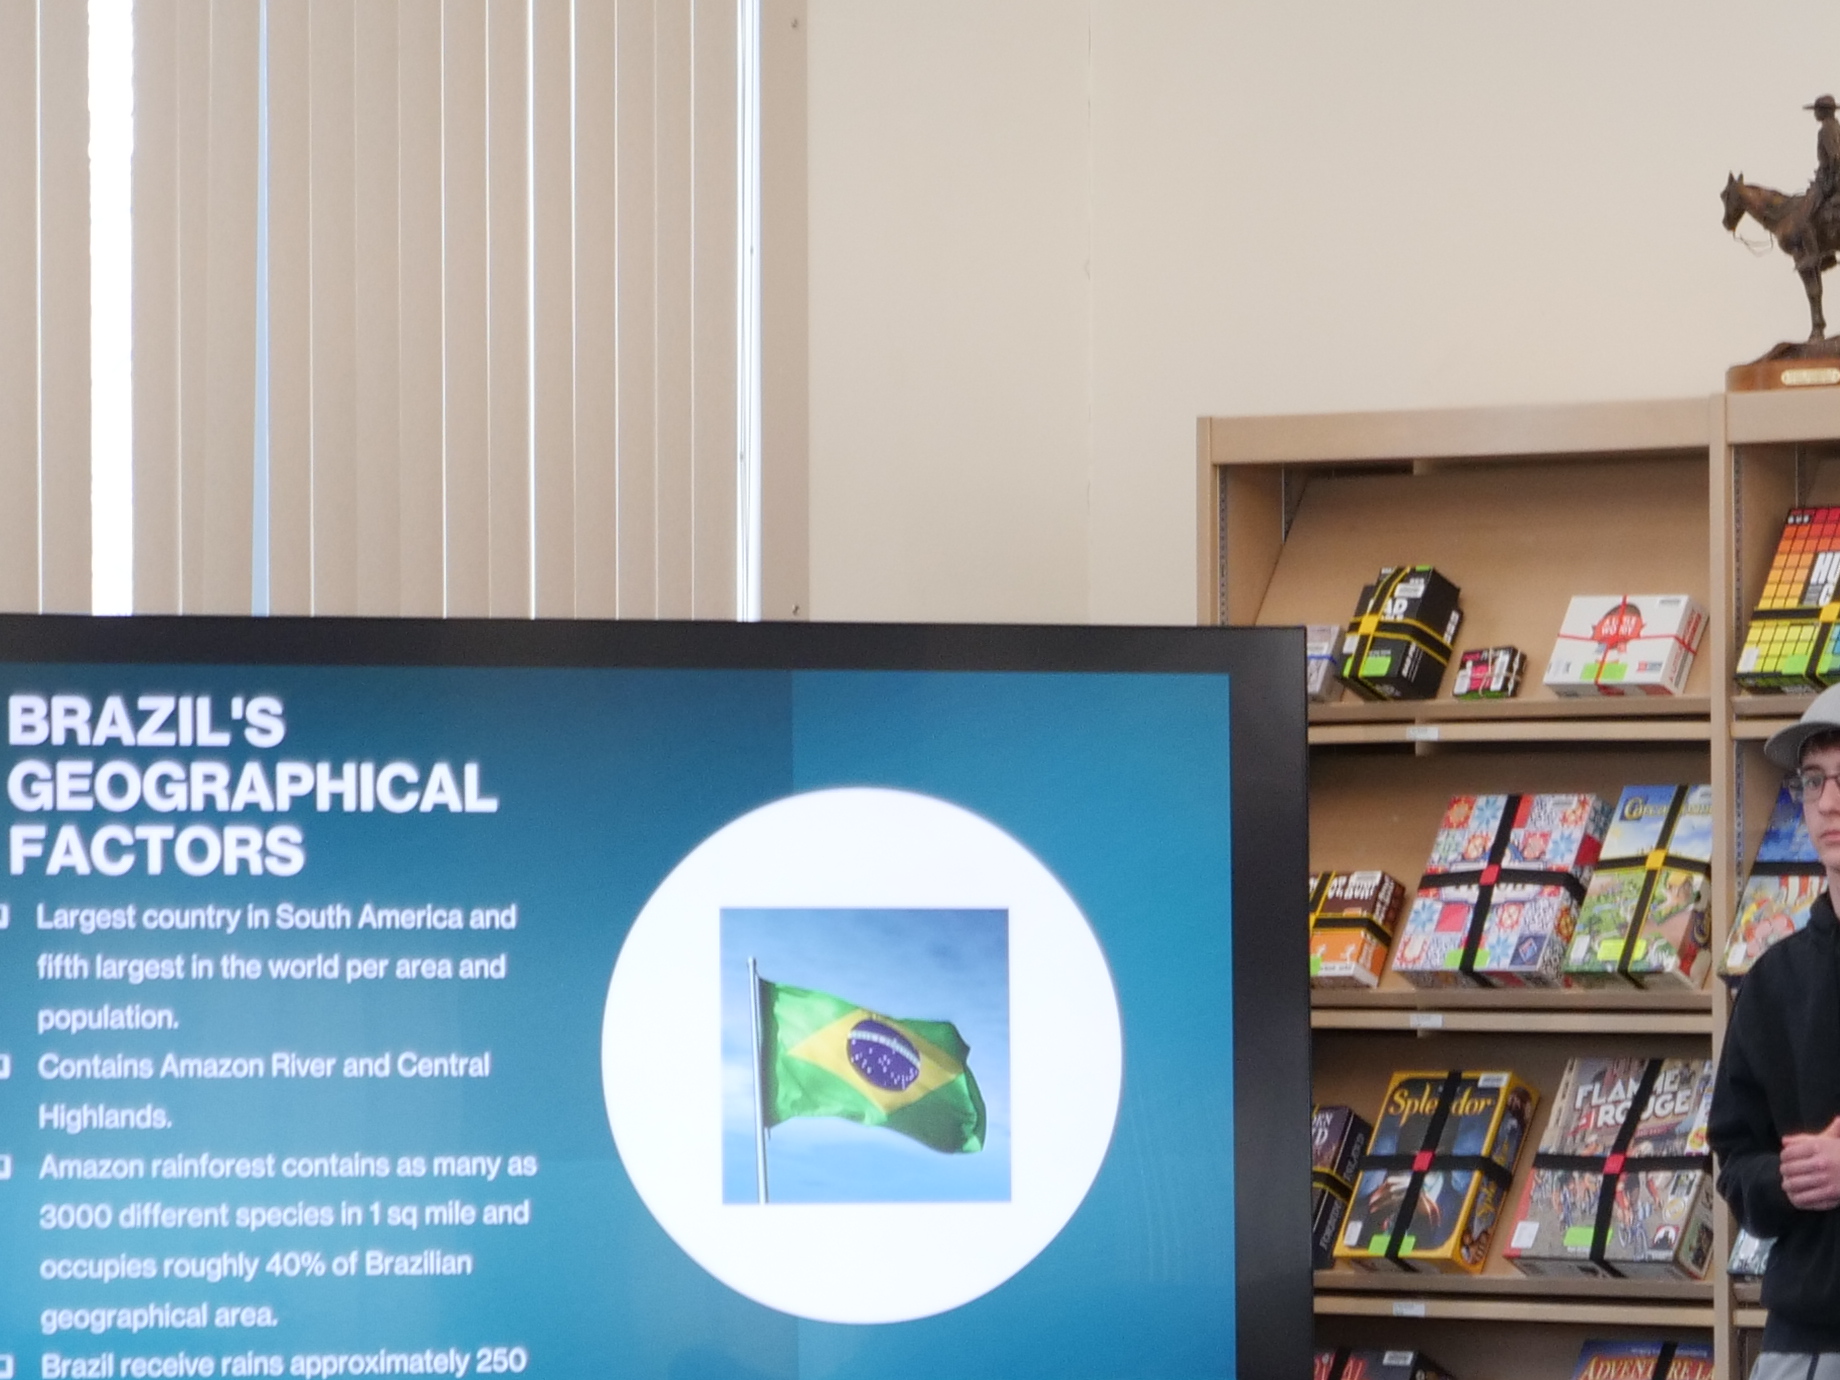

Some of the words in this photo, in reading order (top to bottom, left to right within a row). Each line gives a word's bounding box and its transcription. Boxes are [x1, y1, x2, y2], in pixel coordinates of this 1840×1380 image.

[8, 695, 285, 748] BRAZIL'S
[7, 759, 498, 813] GEOGRAPHICAL
[9, 824, 305, 877] FACTORS
[37, 904, 136, 934] Largest
[142, 905, 241, 934] country
[247, 904, 270, 929] in
[276, 903, 352, 929] South
[358, 903, 464, 929] America
[469, 904, 517, 929] and
[37, 953, 89, 979] fifth
[95, 954, 185, 985] largest
[191, 954, 214, 979] in
[220, 953, 262, 980] the
[267, 953, 340, 979] world
[345, 958, 389, 984] per
[395, 958, 453, 979] area
[458, 954, 506, 979] and
[38, 1003, 179, 1034] population.
[38, 1052, 155, 1079] Contains
[160, 1052, 265, 1079] Amazon
[271, 1051, 337, 1078] River
[342, 1052, 391, 1078] and
[396, 1051, 490, 1078] Central
[39, 1103, 172, 1134] Highlands.
[1387, 1081, 1492, 1127] Spledor
[39, 1153, 145, 1180] Amazon
[151, 1152, 276, 1179] rainforest
[281, 1151, 391, 1178] contains
[396, 1156, 427, 1178] as
[432, 1156, 502, 1181] many
[507, 1155, 538, 1177] as
[40, 1203, 113, 1230] 3000
[118, 1201, 230, 1229] different
[235, 1201, 336, 1232] species
[340, 1200, 364, 1226] in
[369, 1201, 381, 1226] 1
[387, 1205, 419, 1230] sq
[424, 1200, 477, 1225] mile
[482, 1199, 530, 1225] and
[40, 1253, 158, 1283] occupies
[163, 1251, 260, 1283] roughly
[265, 1251, 327, 1277] 40%
[331, 1250, 359, 1276] of
[365, 1249, 473, 1276] Brazilian
[40, 1302, 208, 1334] geographical
[214, 1306, 279, 1328] area.
[42, 1353, 114, 1379] Brazil
[120, 1352, 215, 1378] receive
[221, 1351, 284, 1377] rains
[290, 1348, 470, 1380] approximately
[476, 1347, 528, 1374] 250
